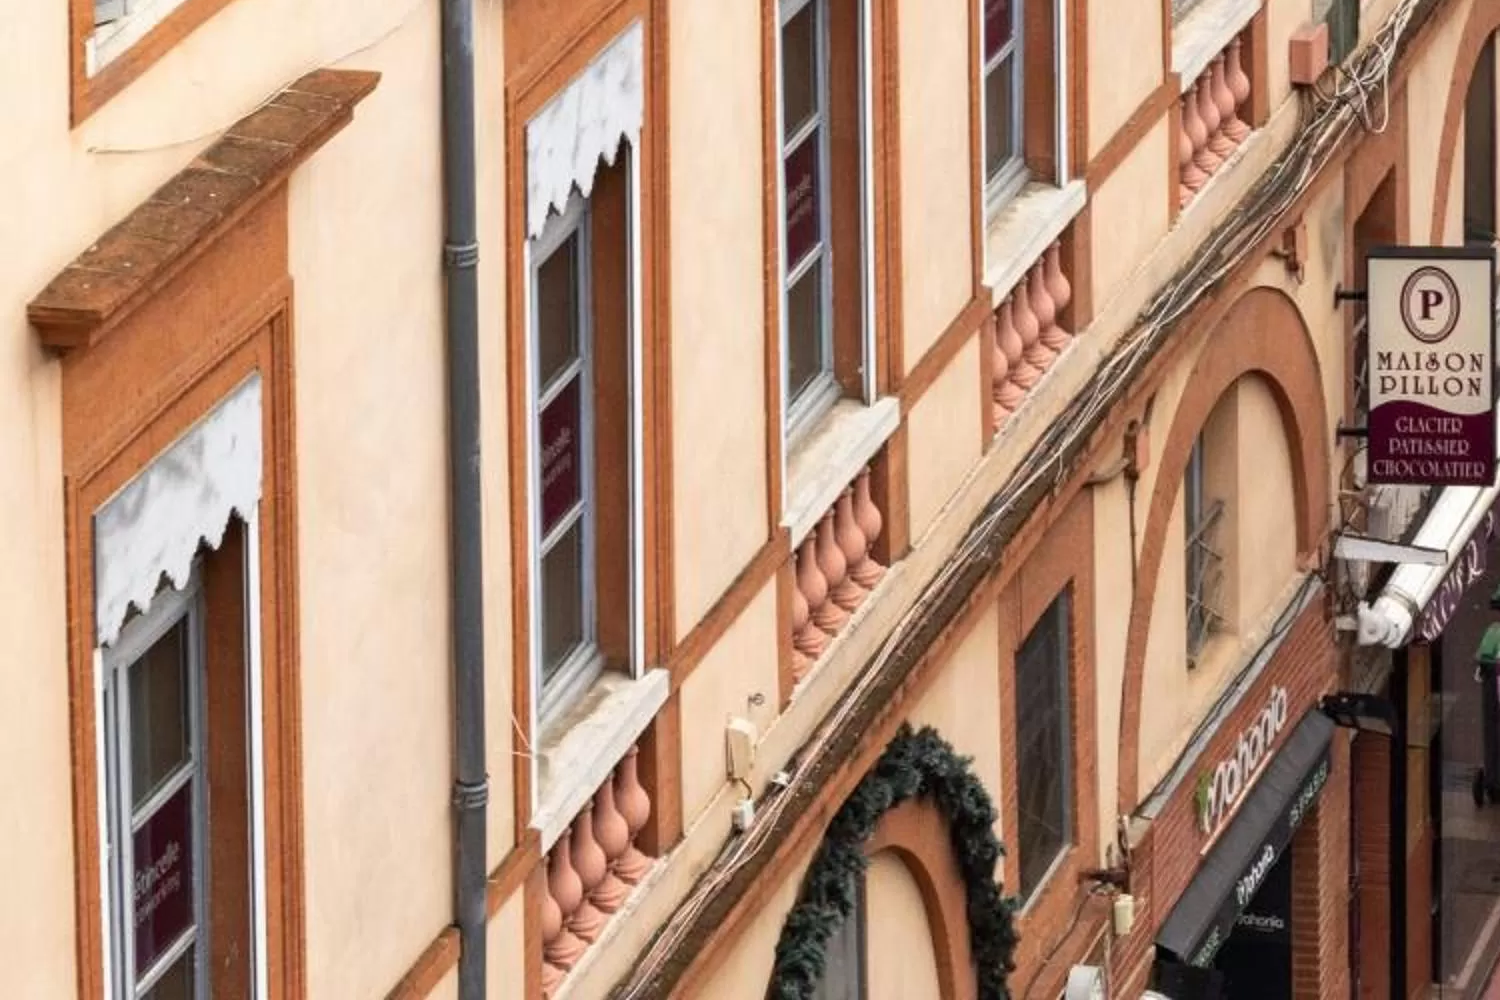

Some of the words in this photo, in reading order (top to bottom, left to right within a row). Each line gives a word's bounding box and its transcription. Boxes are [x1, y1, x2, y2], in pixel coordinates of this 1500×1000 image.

[1418, 289, 1444, 321] P
[1376, 351, 1484, 372] MAISON
[1379, 375, 1482, 397] PILLON
[1395, 416, 1463, 434] GLACIER
[1388, 438, 1470, 456] PATISSIER
[1373, 459, 1485, 477] CHOCOLATIER
